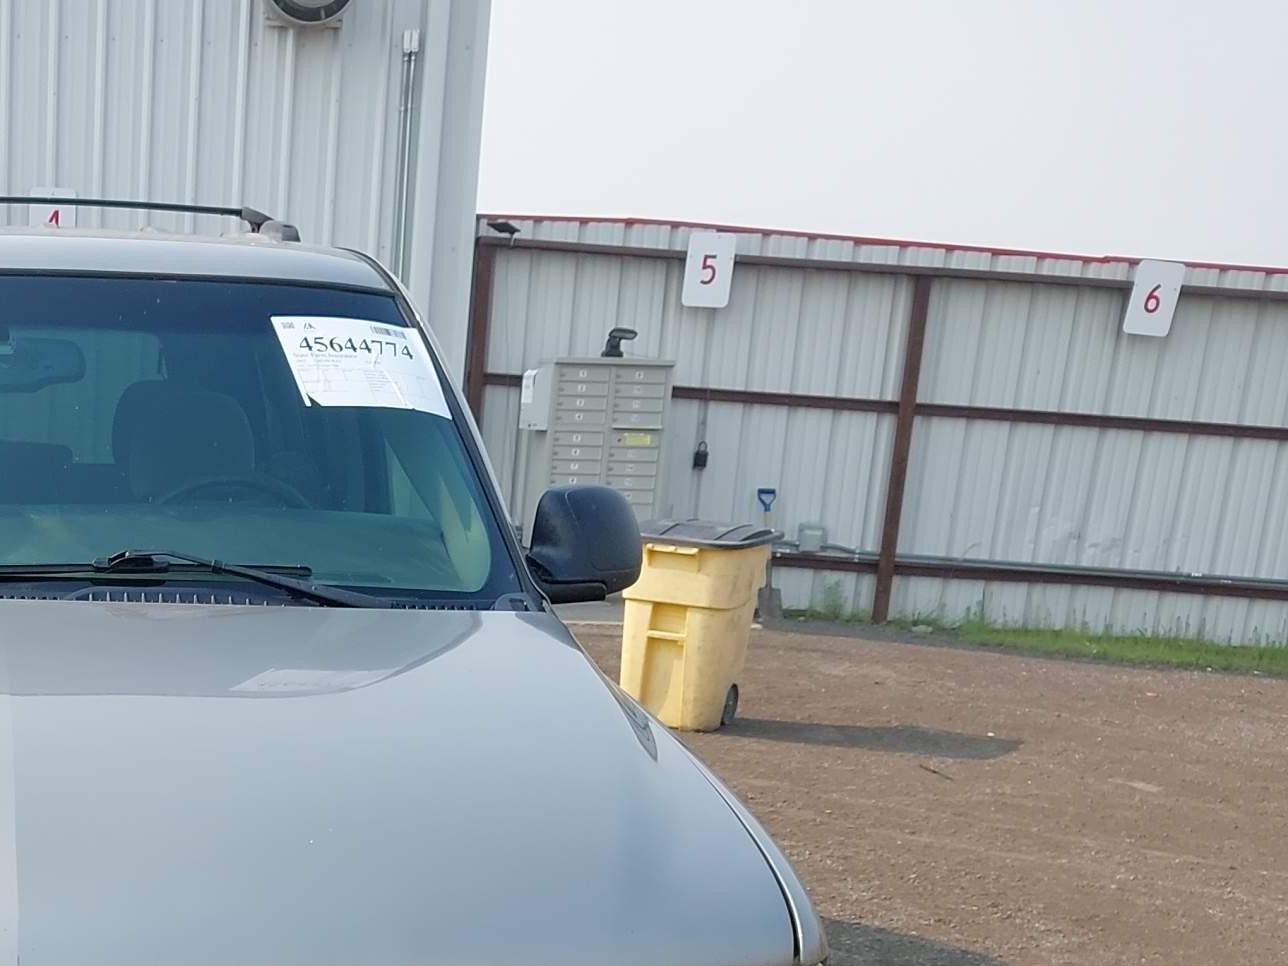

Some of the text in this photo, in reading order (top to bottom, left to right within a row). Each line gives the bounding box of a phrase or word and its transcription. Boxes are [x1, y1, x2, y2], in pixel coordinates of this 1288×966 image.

[699, 254, 718, 285] 5
[1143, 283, 1161, 314] 6
[299, 336, 414, 361] 45644774
